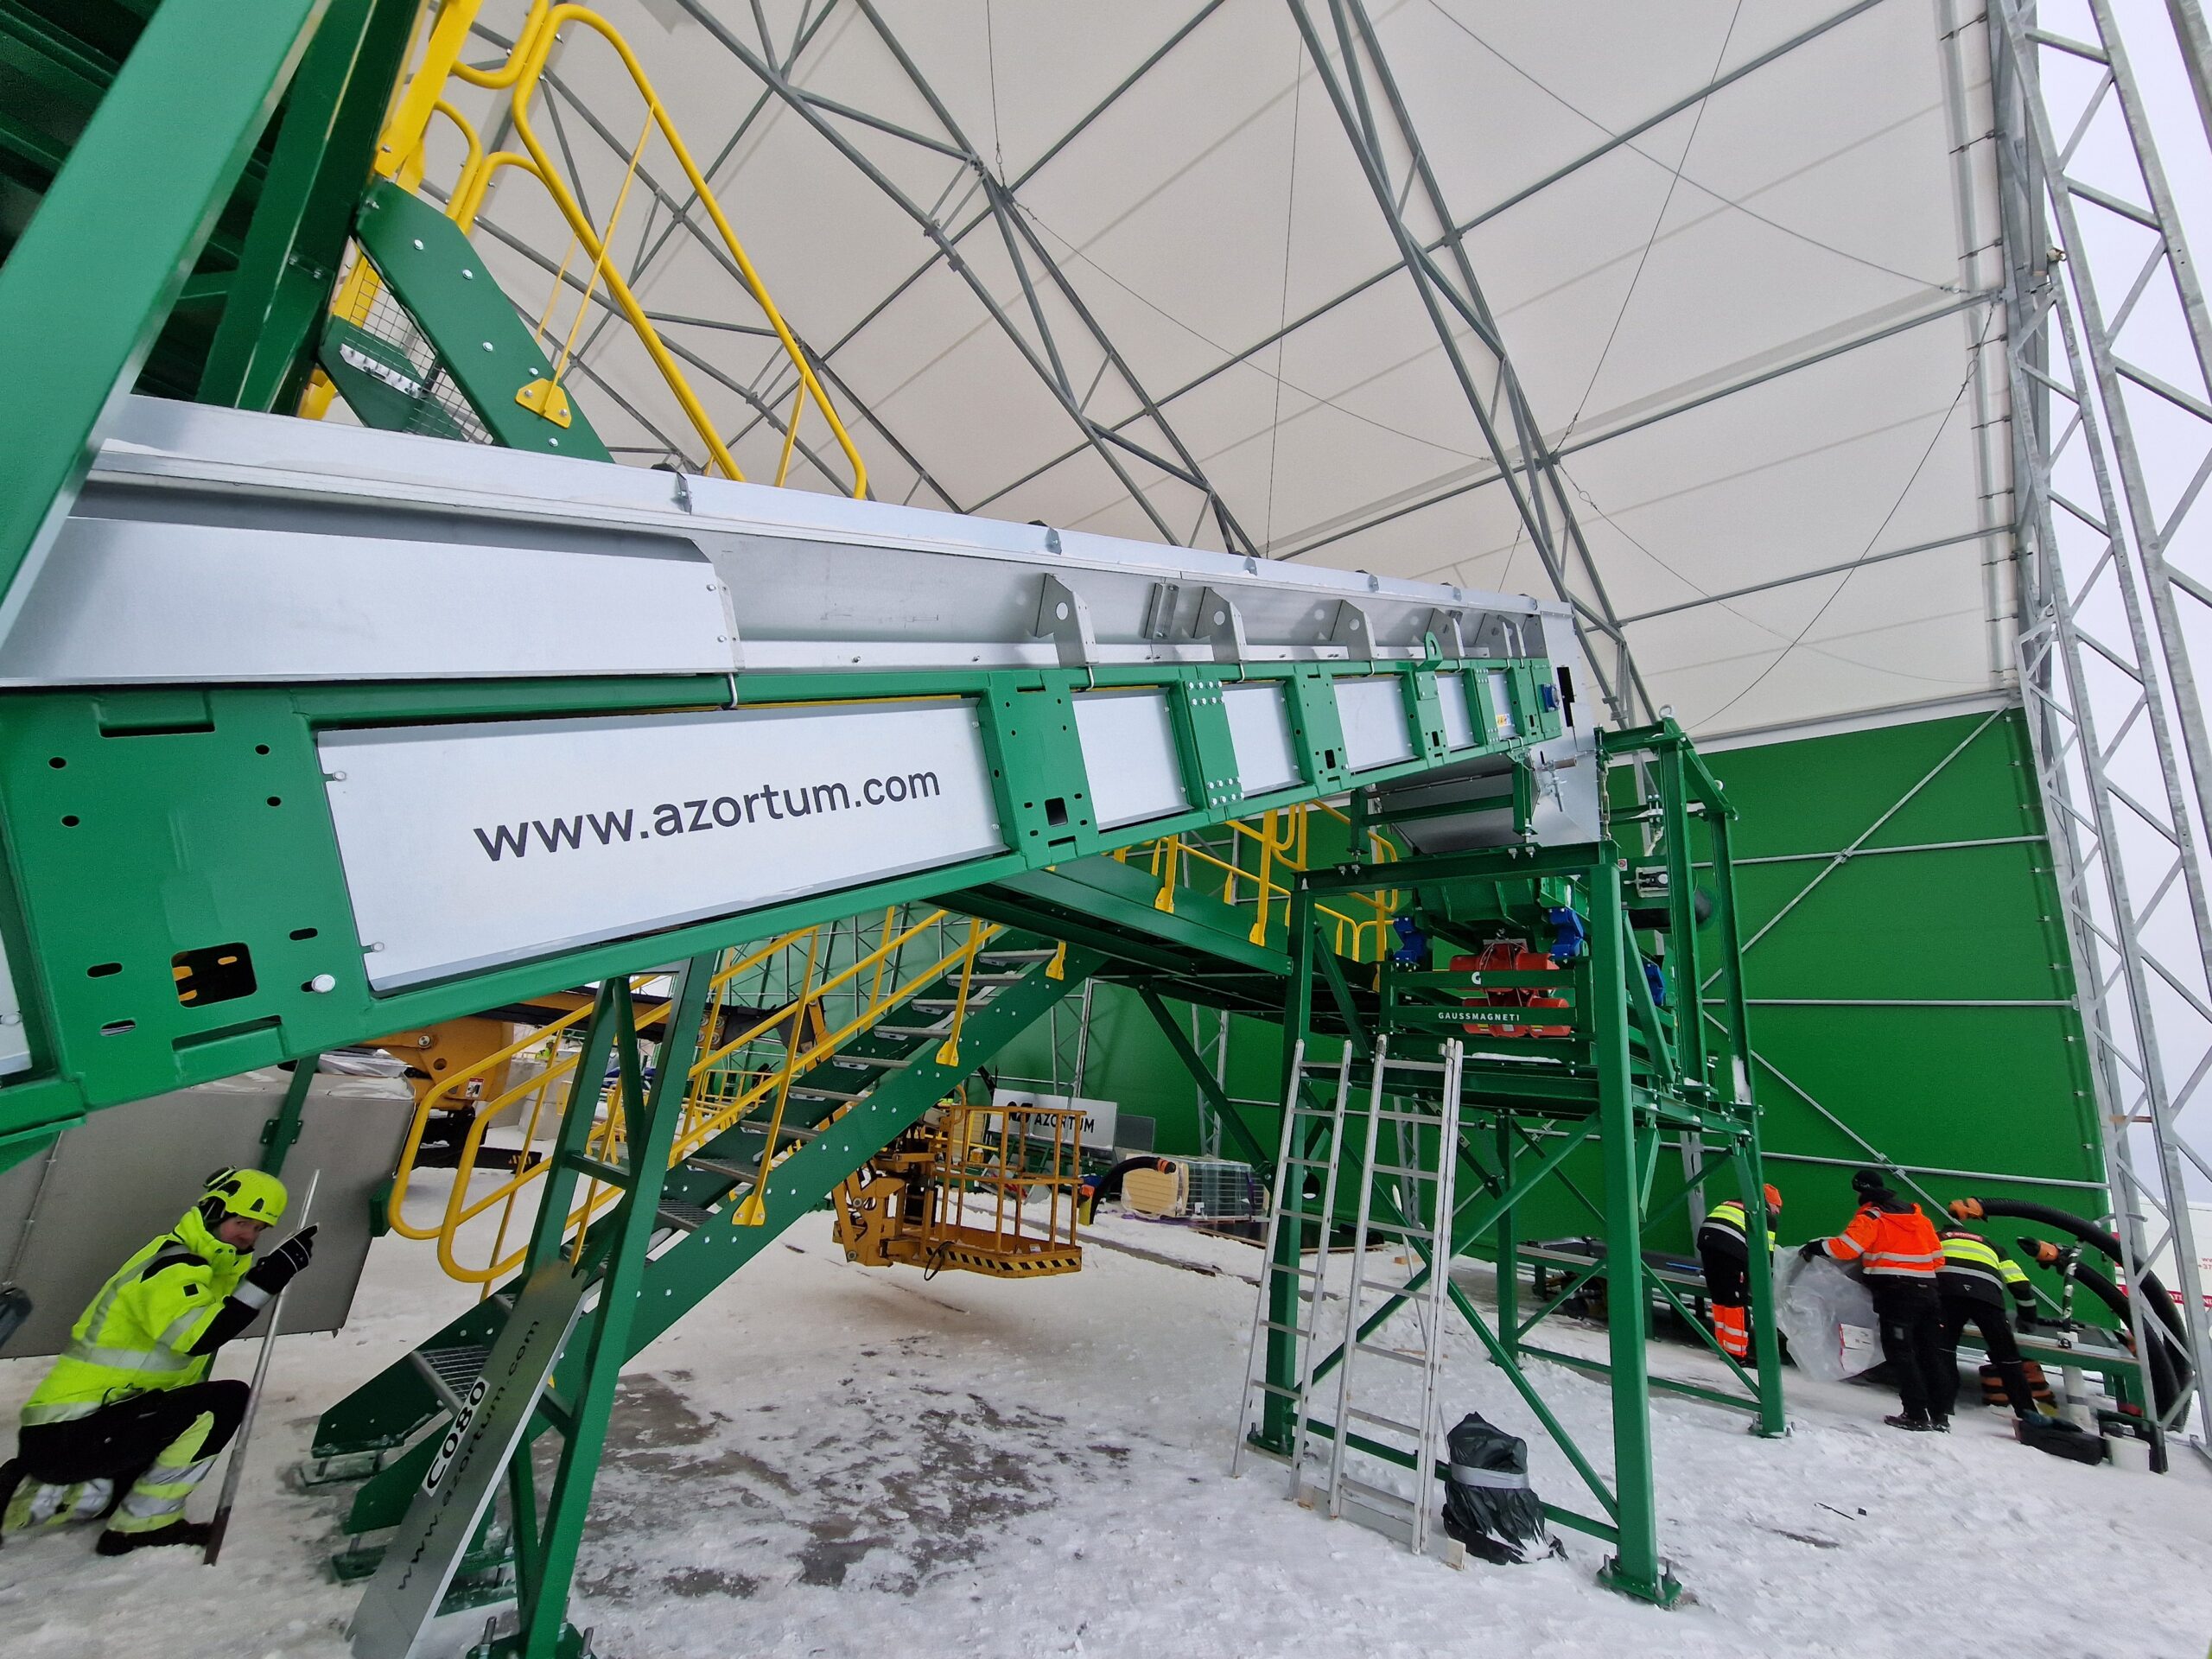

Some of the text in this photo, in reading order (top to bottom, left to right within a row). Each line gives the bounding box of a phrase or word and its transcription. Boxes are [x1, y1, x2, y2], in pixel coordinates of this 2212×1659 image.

[474, 772, 941, 862] www.azortum.com
[1438, 1012, 1520, 1021] GAUSSMAGNETI
[397, 1320, 540, 1591] www.azortum.com
